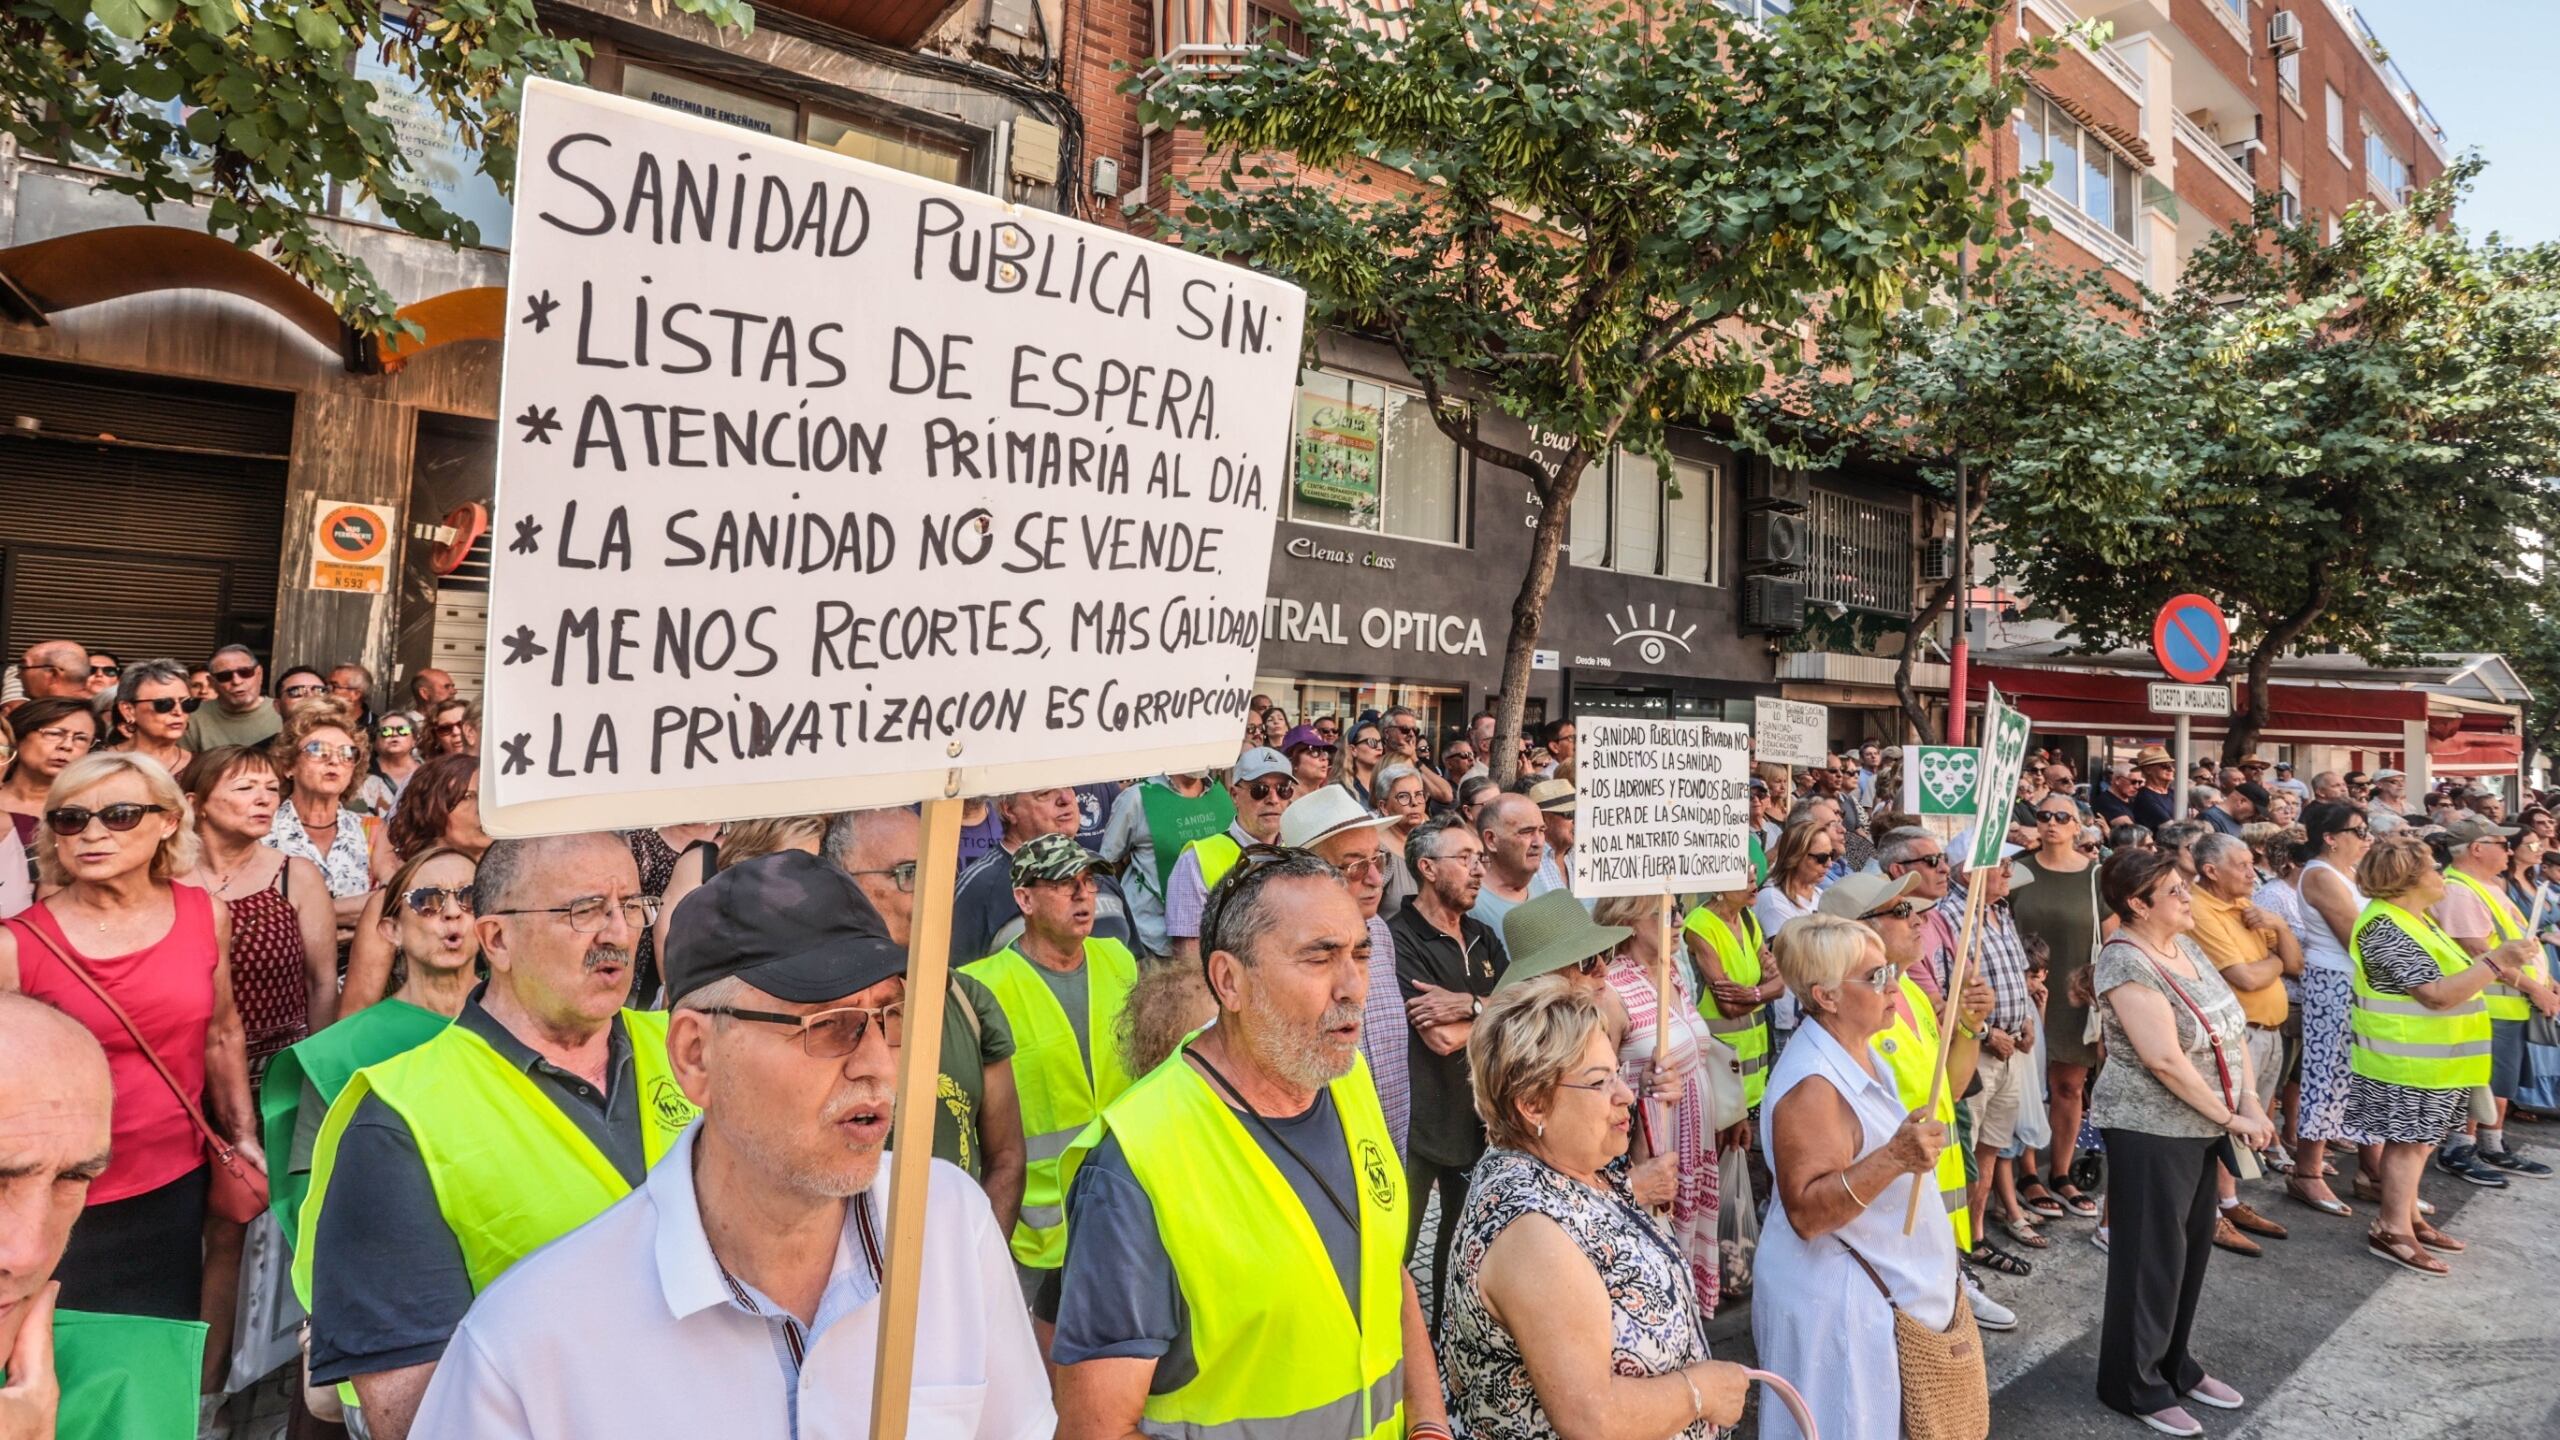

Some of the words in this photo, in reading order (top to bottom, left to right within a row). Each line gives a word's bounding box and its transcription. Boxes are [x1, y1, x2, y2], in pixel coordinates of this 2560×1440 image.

[651, 92, 702, 114] ACADEMIA
[704, 107, 717, 119] DE
[719, 110, 771, 133] ENSEÑANZA
[539, 132, 871, 257] SANIDAD
[914, 198, 1151, 319] PUBLICA
[1177, 281, 1282, 354] SIN:
[576, 276, 847, 388] LISTAS
[889, 325, 974, 400] DE
[1010, 345, 1221, 440] ESPERA.
[573, 393, 888, 475] ATENCION
[1147, 450, 1191, 499] AL
[558, 500, 632, 572] LA
[664, 492, 896, 575] SANIDAD
[918, 508, 994, 571] NO
[1001, 511, 1069, 573] SE
[1081, 514, 1224, 575] VENDE.
[1286, 537, 1355, 564] Elena's
[1362, 550, 1396, 569] class
[344, 577, 364, 589] 593
[551, 605, 779, 687] MENOS
[811, 598, 1052, 678] RECORTES,
[1070, 600, 1150, 655] MAS
[1360, 607, 1488, 657] OPTICA
[1575, 655, 1596, 666] Desde
[2154, 688, 2181, 707] EXCEPTO
[2185, 690, 2226, 710] AMBULANCIAS
[547, 712, 619, 778] LA
[650, 683, 1027, 775] PRIVATIZACION
[1045, 685, 1090, 730] ES
[1762, 721, 1792, 733] SANIDAD
[1773, 710, 1781, 721] LO
[1786, 712, 1819, 728] PUBLICO
[1593, 724, 1646, 748] SANIDAD
[1650, 723, 1688, 747] PUBLICA
[1701, 725, 1733, 749] PRIVADA
[1734, 732, 1749, 751] NO
[1762, 730, 1802, 743] PENSIONES
[1593, 749, 1658, 770] BLINDEMOS
[1662, 752, 1675, 770] LA
[1677, 751, 1722, 773] SANIDAD
[1591, 778, 1611, 798] LOS
[1614, 778, 1665, 798] LADRONES
[1669, 778, 1676, 798] Y
[1678, 778, 1720, 800] FONDOS
[1592, 806, 1632, 828] FUERA
[1634, 805, 1649, 824] DE
[1654, 805, 1669, 823] LA
[1671, 802, 1721, 825] SANIDAD
[1723, 803, 1749, 826] PUBLICA
[1592, 835, 1608, 855] NO
[1610, 835, 1623, 851] AL
[1626, 830, 1680, 849] MALTRATO
[1683, 828, 1740, 849] SANITARIO
[1642, 854, 1677, 879] FUERA
[1678, 854, 1690, 876] TU
